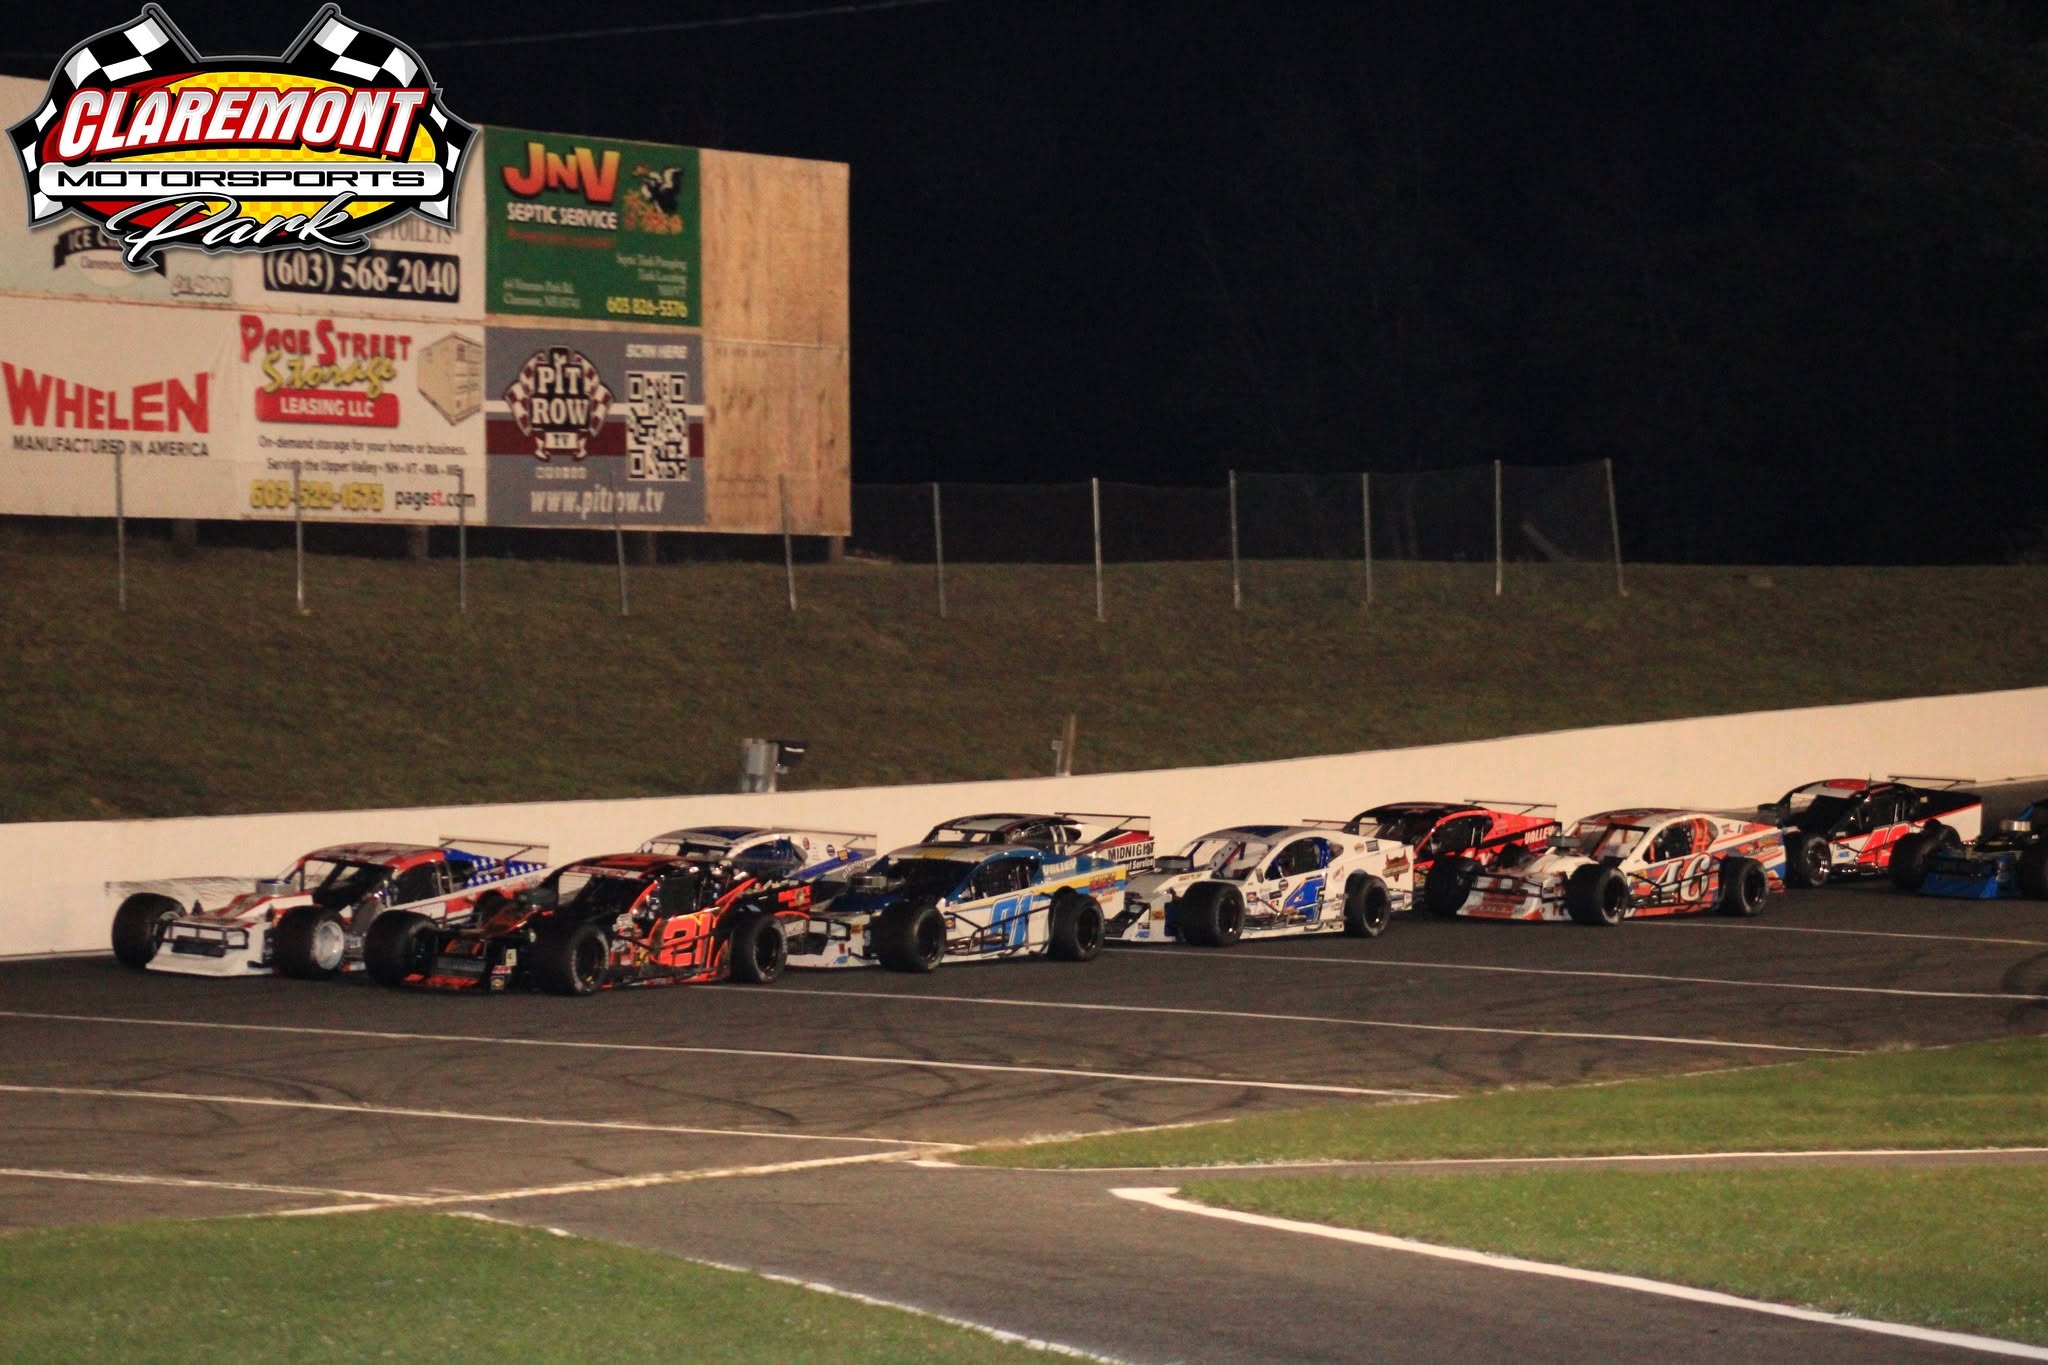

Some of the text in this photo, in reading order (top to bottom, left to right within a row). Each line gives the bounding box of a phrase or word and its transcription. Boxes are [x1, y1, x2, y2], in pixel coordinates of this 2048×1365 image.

[507, 202, 618, 231] SEPTIC SERVICE
[266, 251, 334, 293] (603)
[341, 255, 457, 297] 568-2040
[240, 314, 412, 366] PAGE STREET
[262, 350, 397, 400] Storage
[537, 365, 582, 395] PIT
[1, 361, 209, 433] WHELEN
[280, 396, 375, 418] LEASING LLC
[532, 397, 590, 427] ROW
[13, 435, 209, 457] MANUFACTURED IN AMERICA
[530, 485, 664, 520] www.pitrow.tv
[1650, 853, 1711, 902] 46
